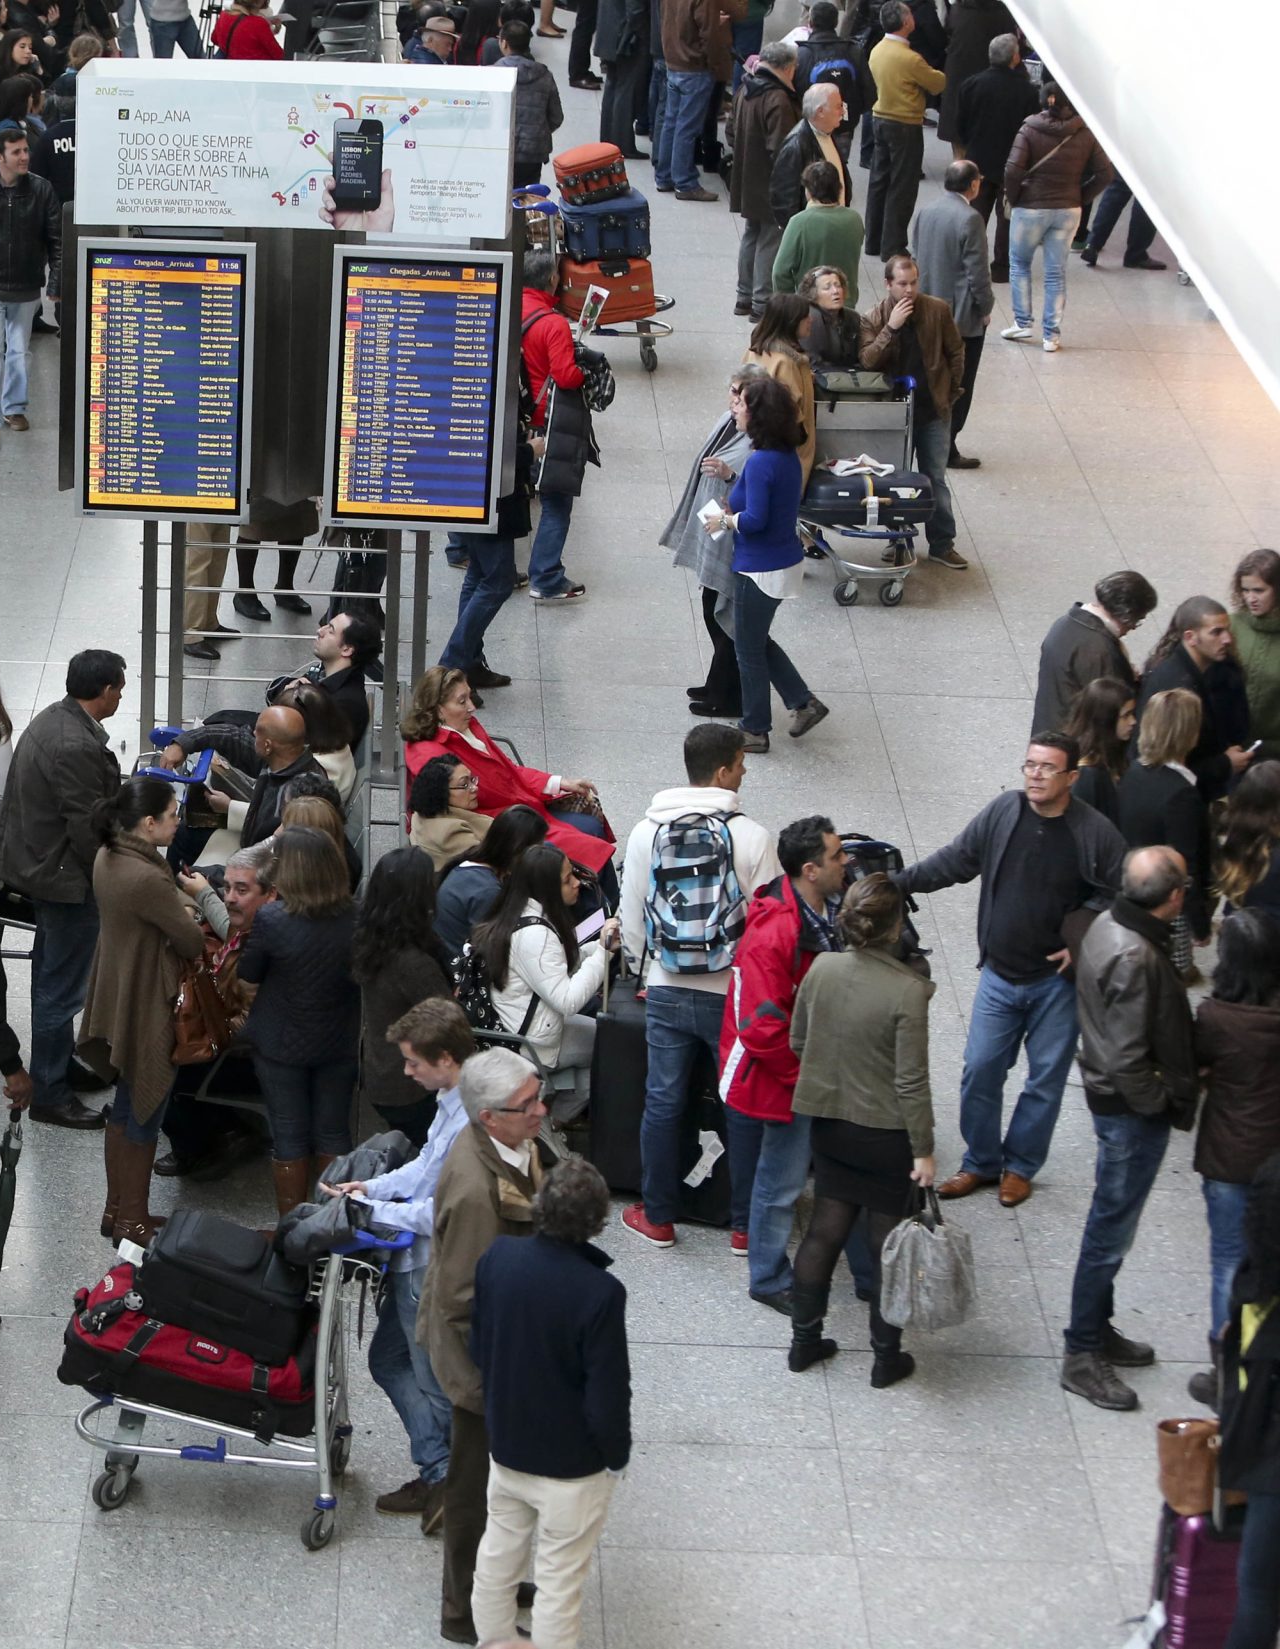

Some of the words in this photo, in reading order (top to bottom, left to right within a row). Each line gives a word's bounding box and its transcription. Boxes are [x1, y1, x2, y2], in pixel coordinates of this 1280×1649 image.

[134, 109, 191, 124] App_ANA
[53, 137, 76, 154] POL
[119, 133, 155, 146] TUDO
[159, 134, 169, 146] O
[172, 134, 198, 149] QUE
[202, 135, 253, 148] SEMPRE
[118, 148, 147, 162] QUIS
[152, 149, 190, 162] SABER
[194, 150, 235, 163] SOBRE
[238, 152, 247, 163] A
[118, 163, 142, 176] SUA
[146, 164, 195, 177] VIAGEM
[199, 165, 228, 178] MAS
[232, 166, 270, 179] TINHA
[117, 178, 134, 190] DE
[138, 179, 218, 194] PERGUNTAR_
[134, 259, 165, 268] Chegadas
[390, 268, 420, 276] Chegadas
[196, 1341, 218, 1354] ROOTS
